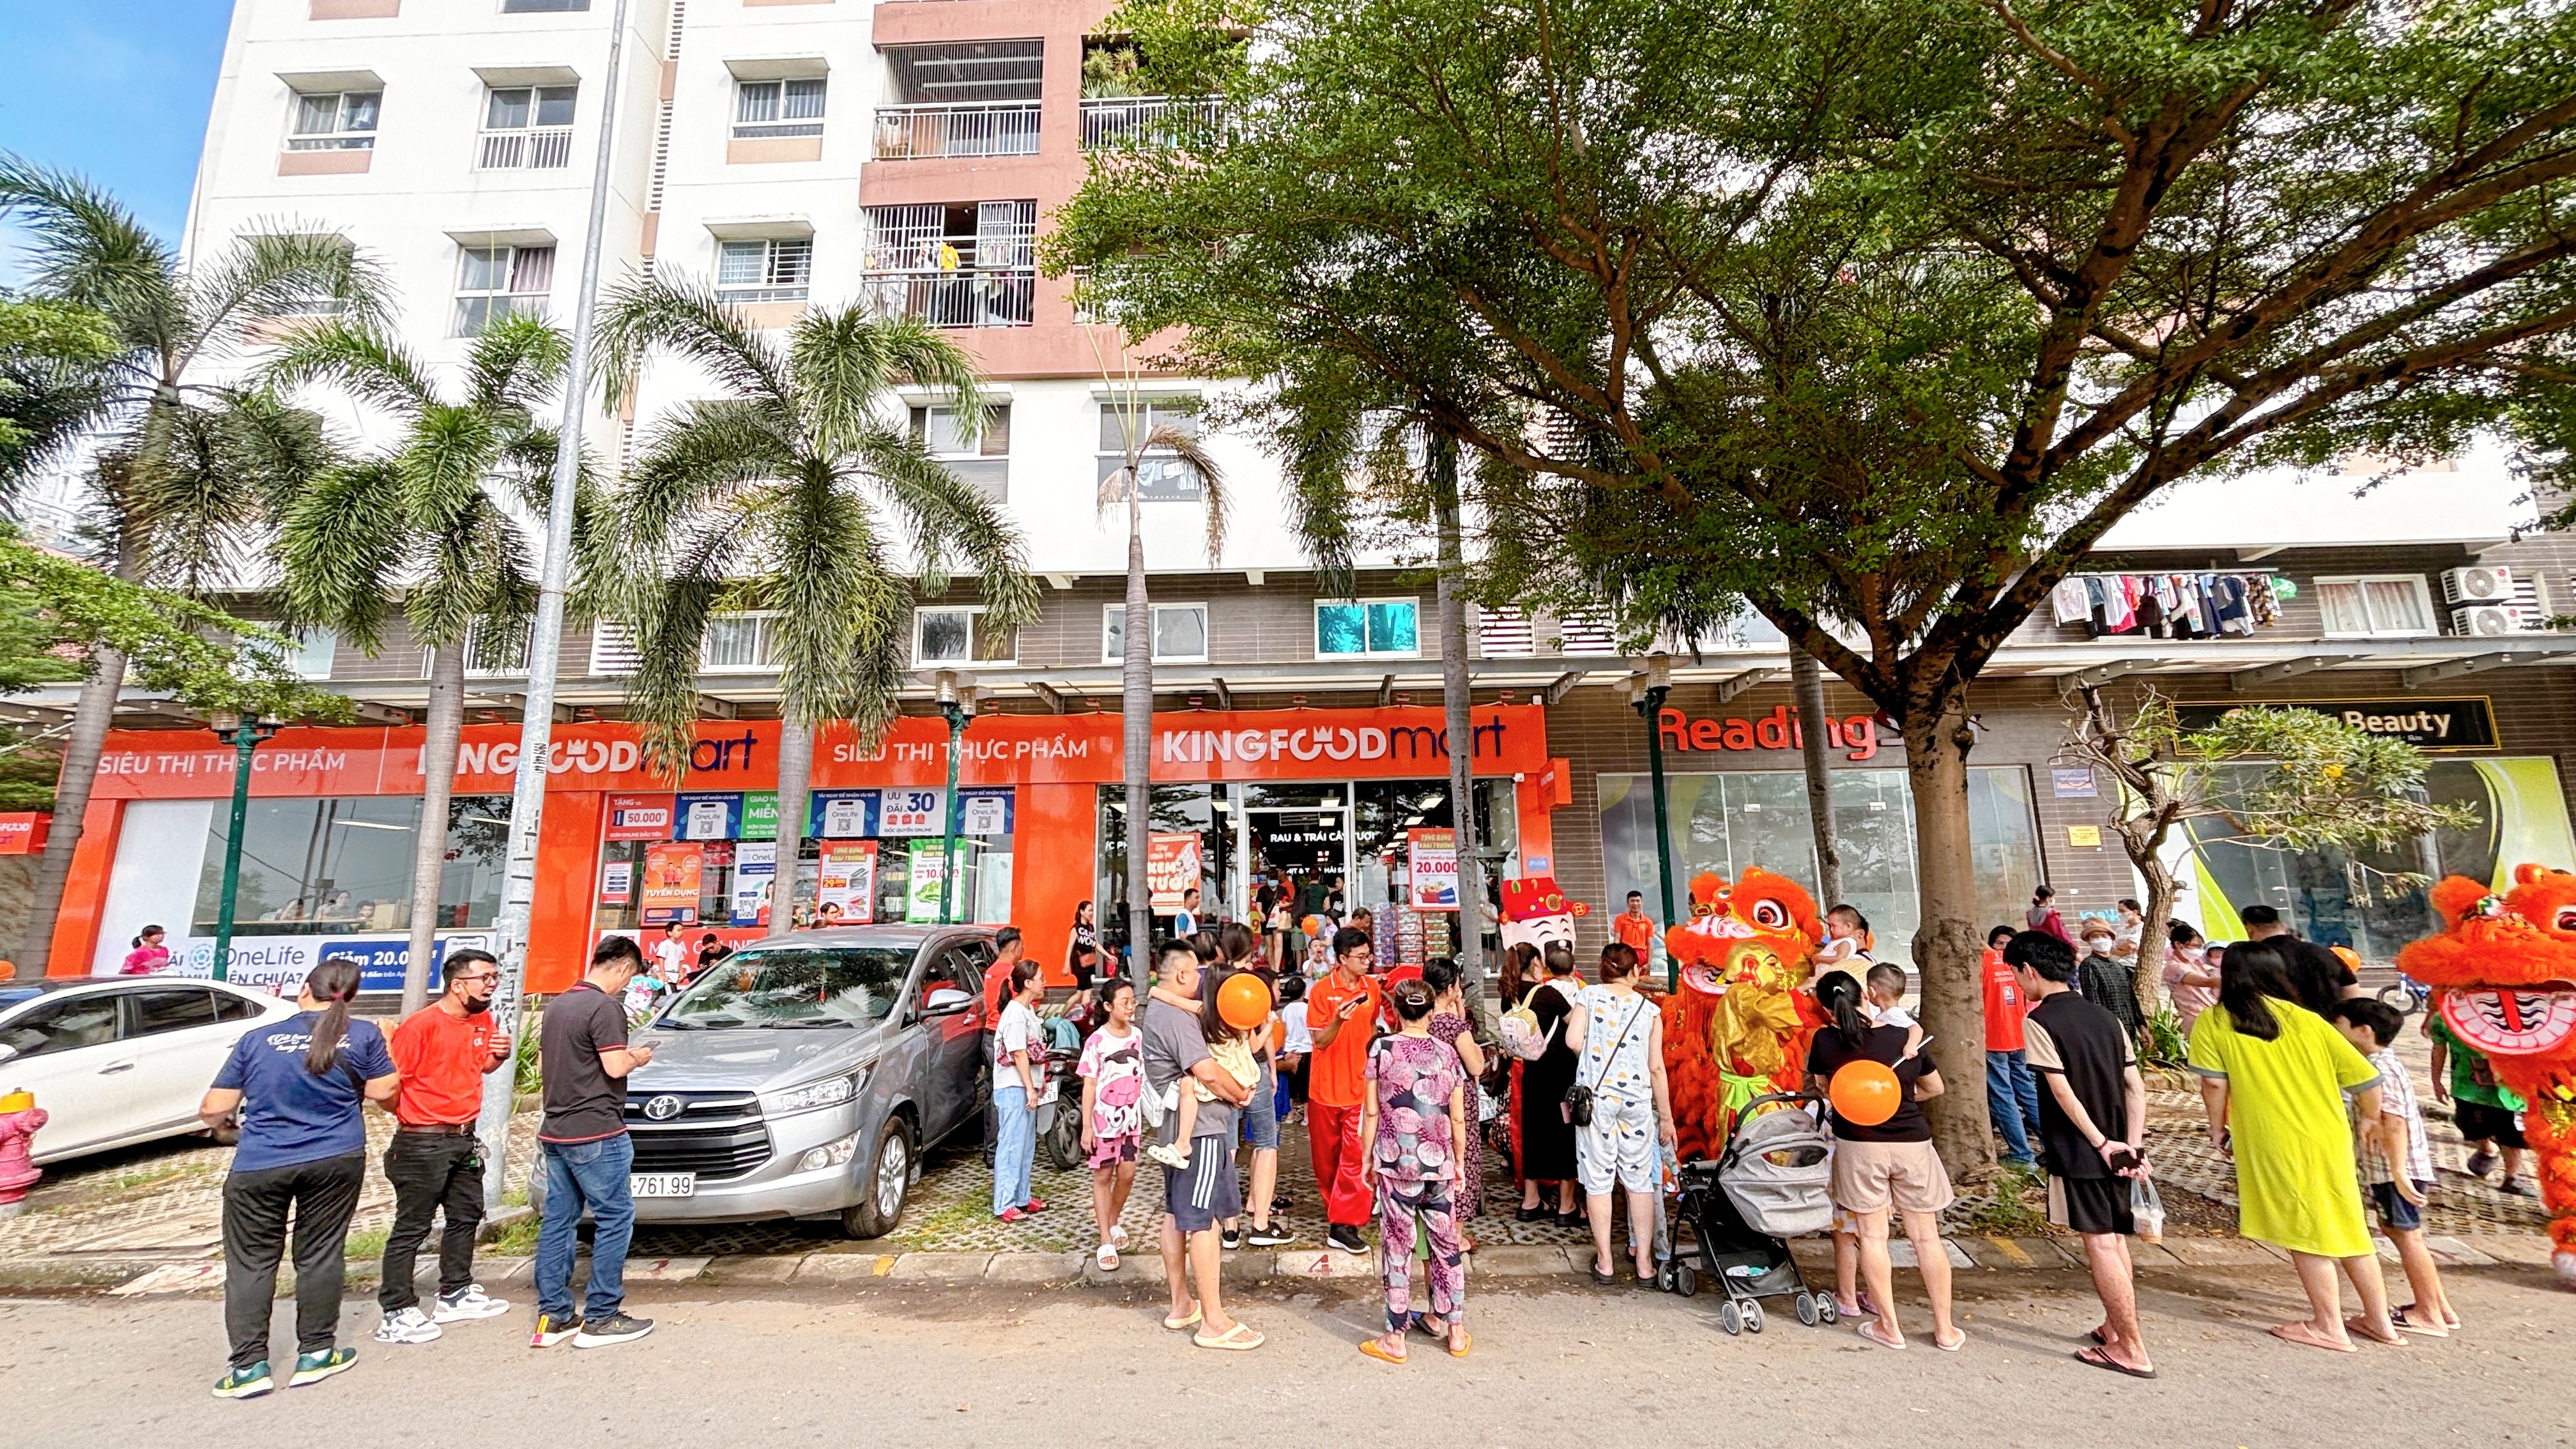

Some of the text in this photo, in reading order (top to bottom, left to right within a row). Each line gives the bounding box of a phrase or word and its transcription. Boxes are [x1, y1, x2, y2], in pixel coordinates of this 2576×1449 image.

[2343, 710, 2451, 737] Beauty
[417, 729, 757, 775] NGOODart
[894, 742, 933, 765] THỊ
[941, 739, 1008, 764] THỰC
[1015, 733, 1087, 758] PHẨM
[97, 746, 346, 777] SIÊU THỊ THC PHẨM
[613, 797, 634, 807] TẶNG
[887, 792, 901, 800] ƯU
[748, 804, 778, 819] MIỄN
[887, 803, 902, 813] ĐÃI
[1270, 833, 1291, 842] RAU
[1294, 833, 1301, 842] &
[1303, 831, 1326, 842] TRÁI
[1354, 831, 1375, 841] ƯƠI
[1147, 862, 1176, 874] KEM
[1416, 861, 1459, 873] 20.000
[646, 887, 699, 897] TUYỂN DỤNG
[649, 940, 688, 955] MA
[169, 946, 305, 966] ẢI OneLife
[253, 972, 303, 985] CHƯA?
[629, 1177, 690, 1195] -761.99
